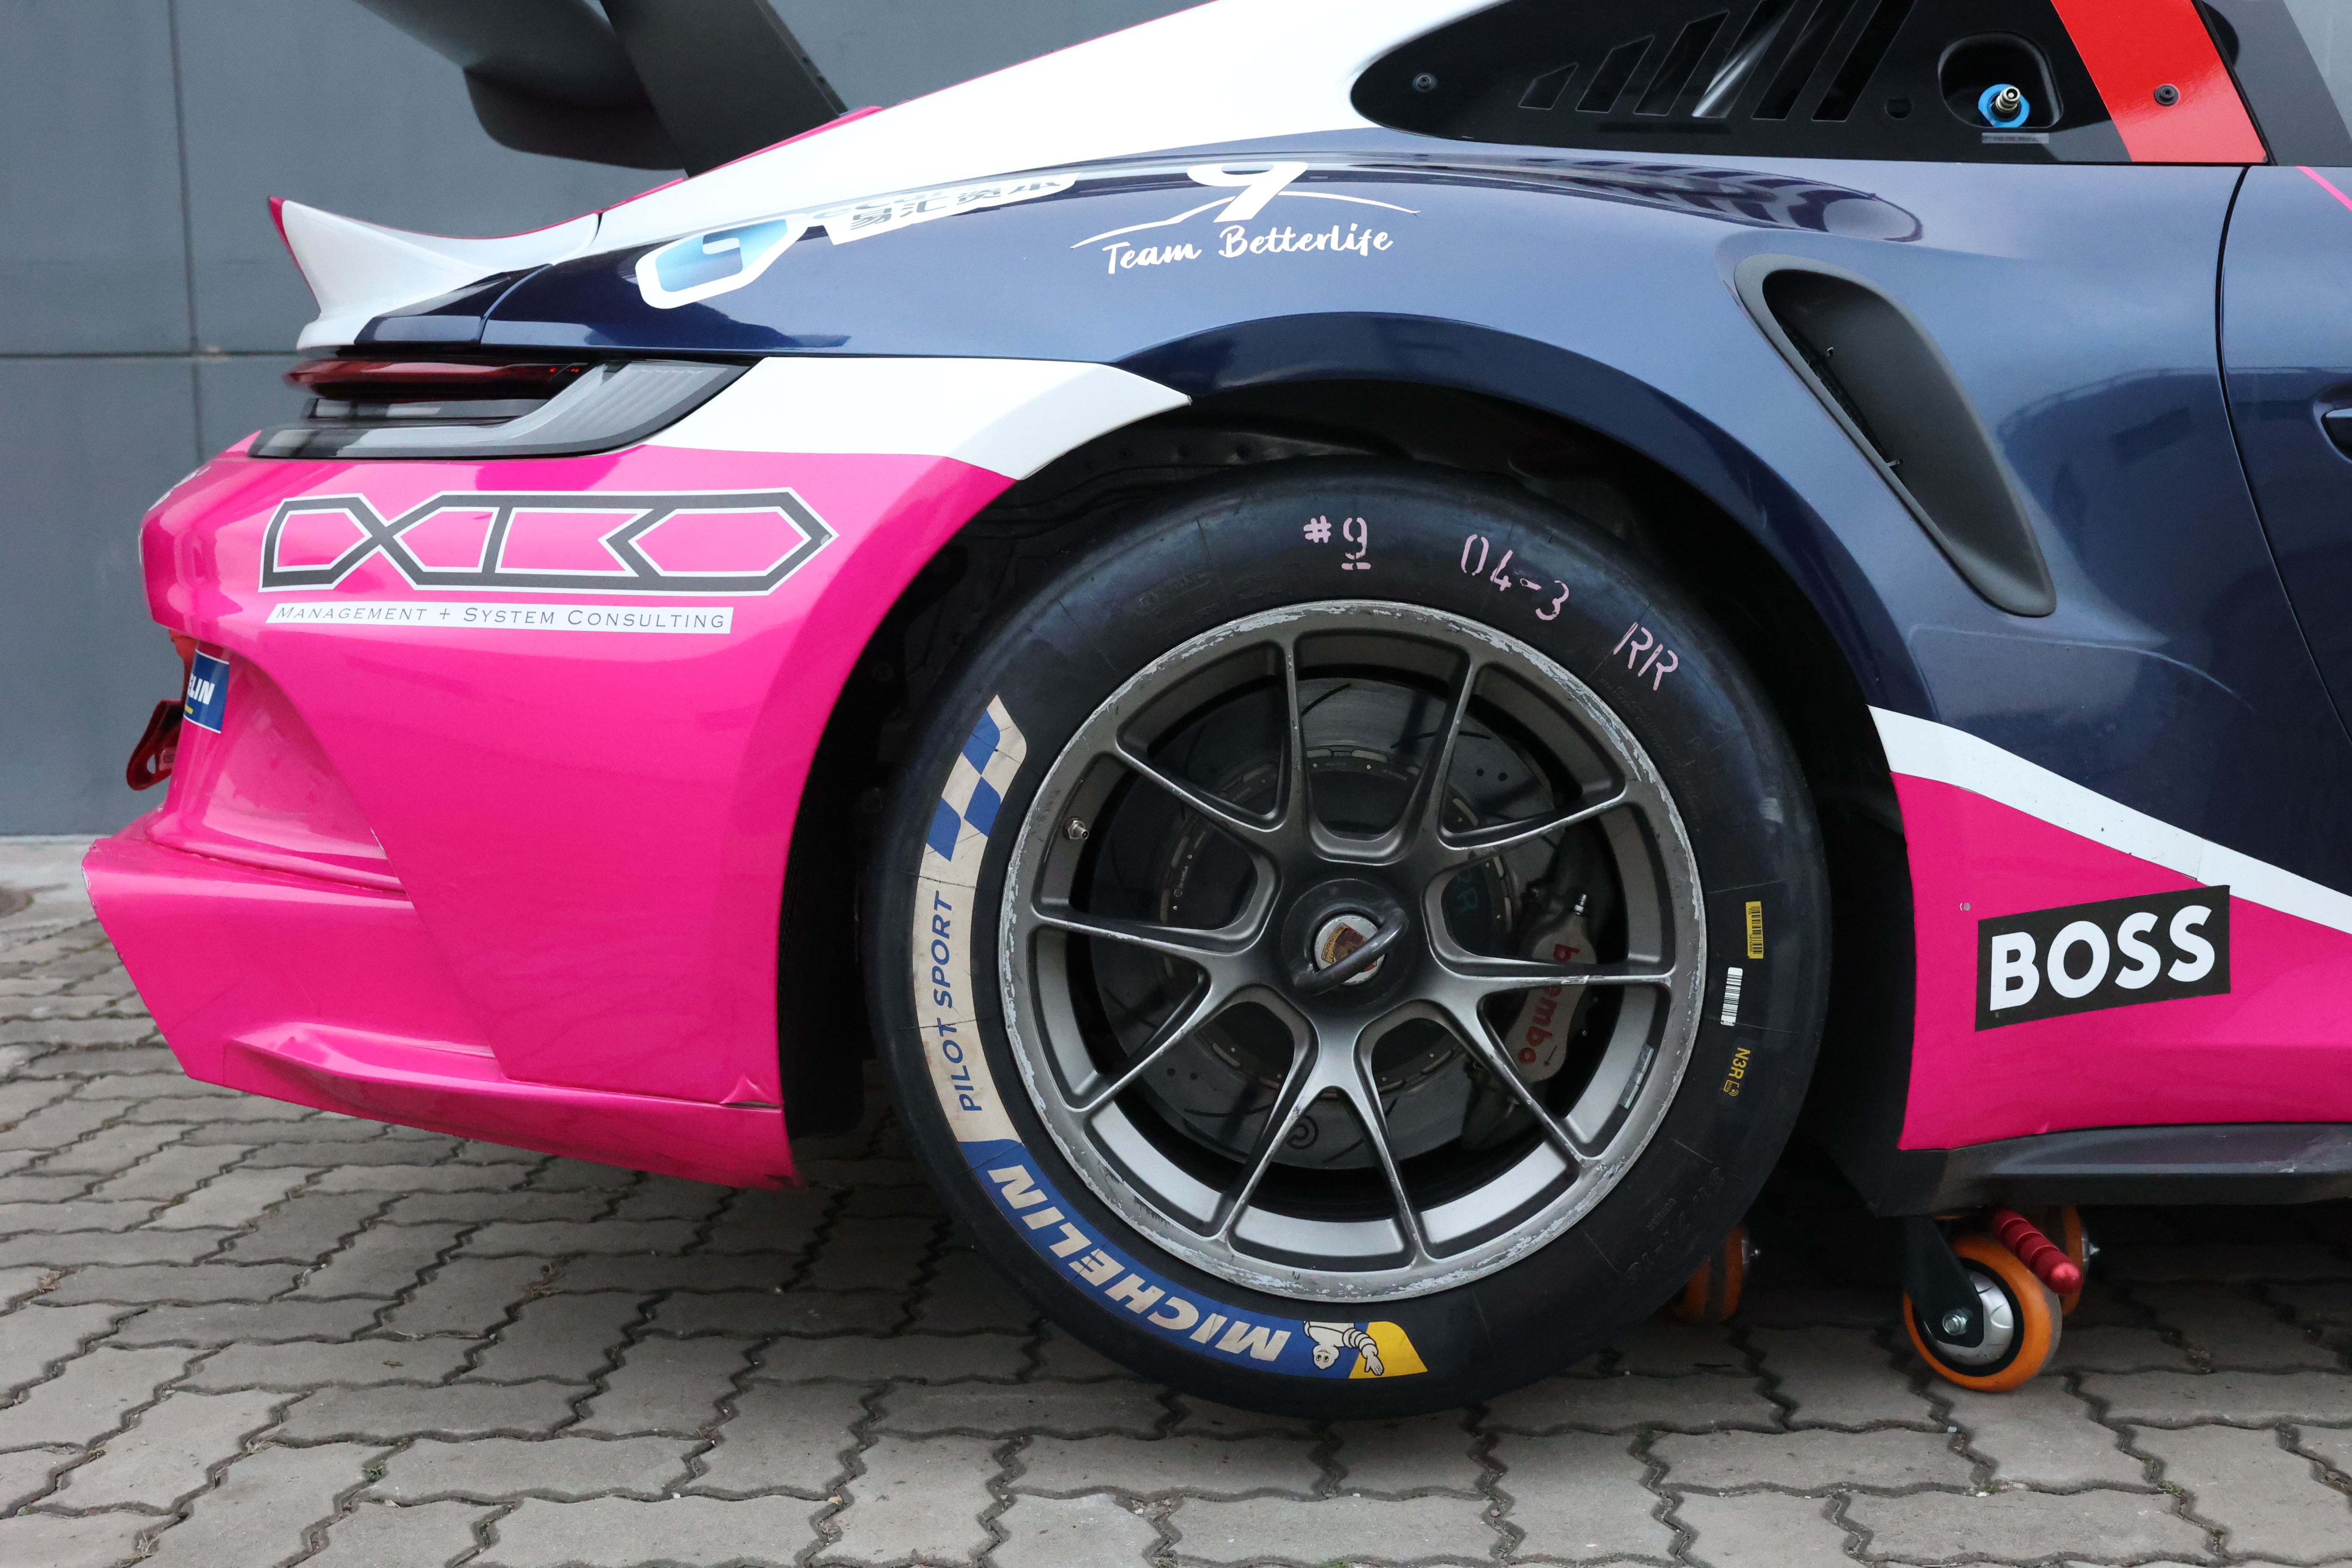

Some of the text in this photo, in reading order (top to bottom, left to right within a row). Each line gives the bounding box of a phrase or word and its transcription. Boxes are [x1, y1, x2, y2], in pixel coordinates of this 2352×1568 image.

[1102, 223, 1393, 274] Team Betterlife
[276, 606, 427, 620] MANAGEMENT
[464, 607, 555, 624] SYSTEM
[568, 610, 724, 628] CONSULTING
[1461, 534, 1569, 620] 04-3
[1613, 622, 1678, 691] RR
[931, 890, 982, 1111] PILOT SPORT
[1518, 944, 1580, 1065] bembo
[1990, 905, 2215, 1011] BOSS
[1728, 1047, 1751, 1079] N3R
[988, 1164, 1291, 1362] MICHELIN
